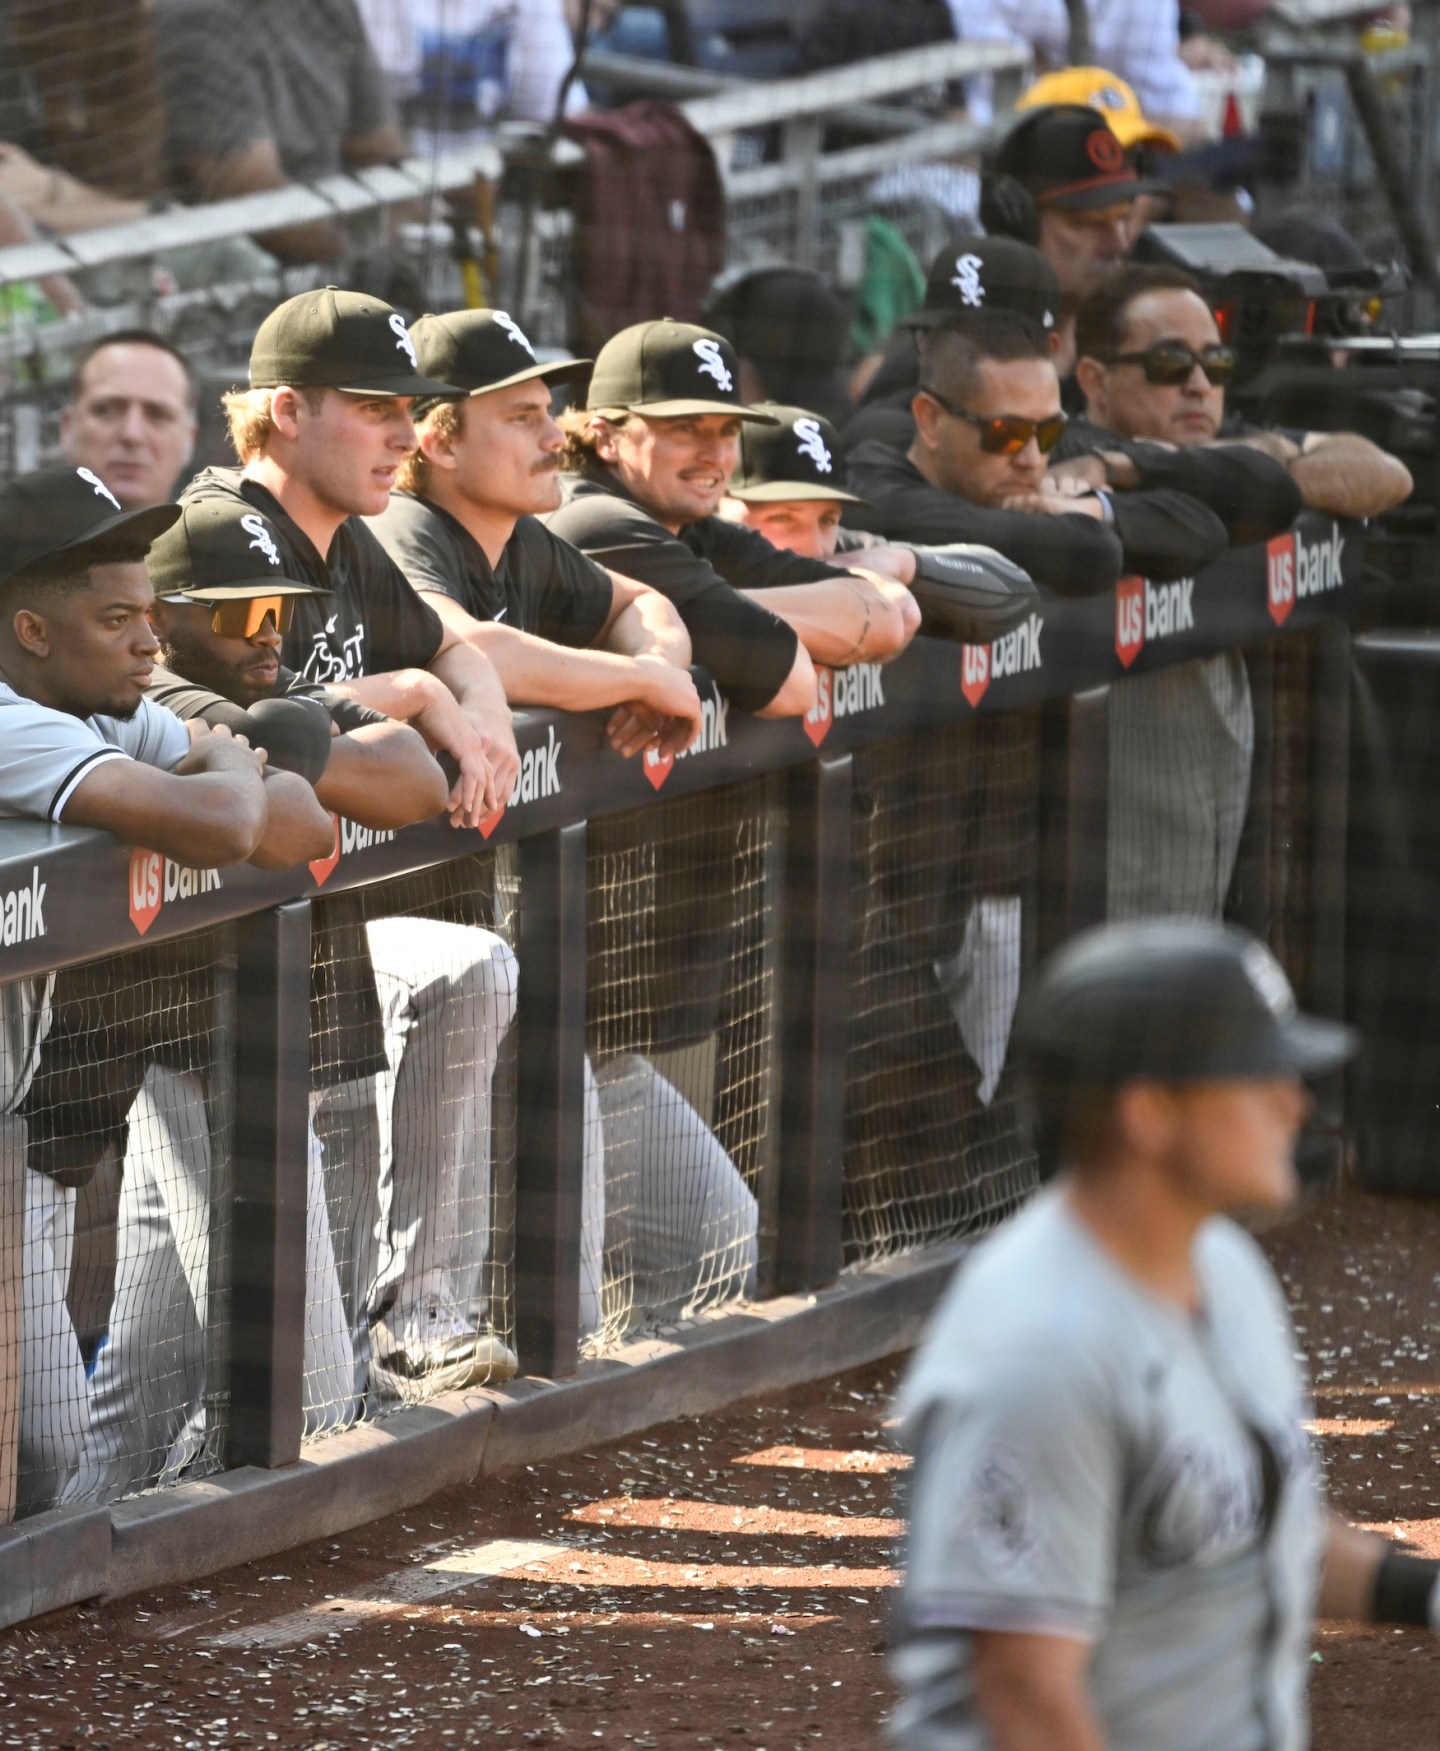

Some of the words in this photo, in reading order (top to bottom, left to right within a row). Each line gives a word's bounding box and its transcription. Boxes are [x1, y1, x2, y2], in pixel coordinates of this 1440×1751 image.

[1268, 552, 1293, 604] us
[1295, 522, 1345, 598] bank
[1118, 599, 1142, 648] us
[1144, 578, 1194, 641] bank
[964, 643, 988, 686] us
[990, 613, 1044, 679] bank
[133, 853, 161, 913] us
